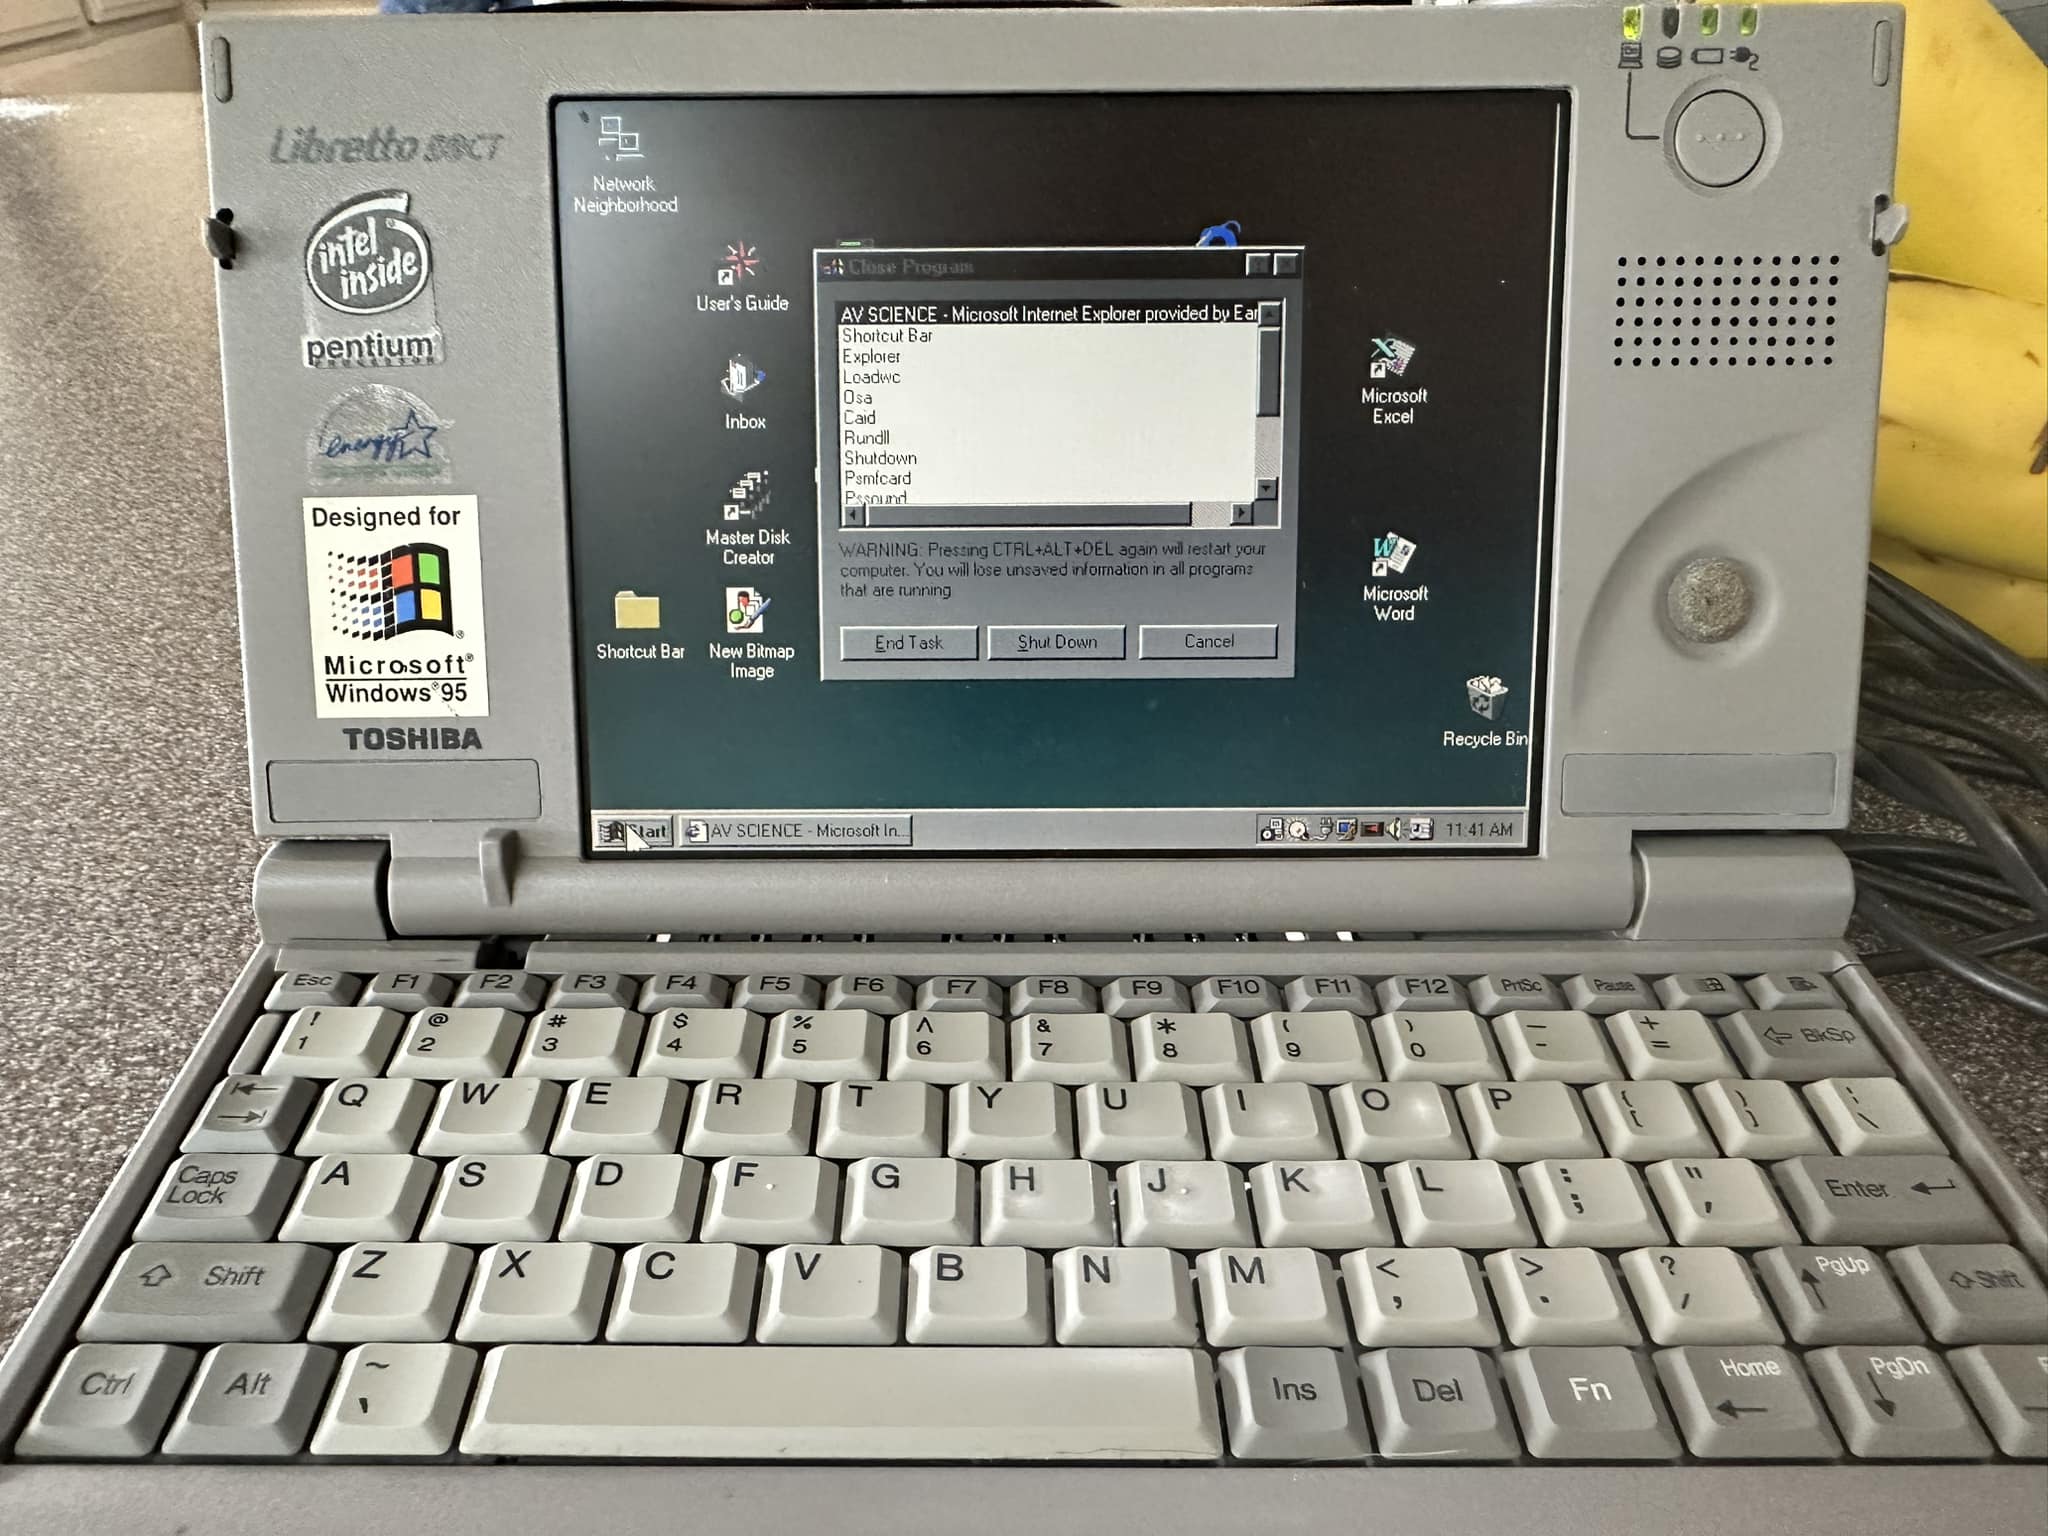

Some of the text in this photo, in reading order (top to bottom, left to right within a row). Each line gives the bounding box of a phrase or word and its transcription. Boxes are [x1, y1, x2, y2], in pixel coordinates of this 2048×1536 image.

[593, 175, 656, 192] Network
[574, 197, 678, 215] Neighborhood
[317, 216, 378, 274] intel
[340, 247, 418, 300] inside
[849, 259, 975, 277] Close Program
[697, 295, 789, 311] User's Guide
[841, 307, 865, 323] AV
[868, 306, 937, 322] SCIENCE
[952, 305, 1018, 322] Microsoft
[1022, 304, 1078, 321] Internet
[1082, 305, 1141, 324] Explorer
[1146, 304, 1207, 324] provided
[1212, 304, 1230, 323] by
[842, 328, 933, 343] Shortcut Bar
[307, 332, 433, 366] pentium
[843, 348, 901, 366] Explorer
[843, 369, 901, 384] Loadwc
[844, 390, 872, 405] Osa
[1361, 387, 1428, 404] Microsoft
[725, 413, 766, 429] Inbox
[844, 410, 876, 425] Caid
[1373, 408, 1414, 425] Excel
[844, 429, 890, 445] Rundll
[844, 451, 917, 466] Shutdown
[845, 470, 912, 486] Psmfcard
[845, 490, 907, 504] Pssound
[312, 505, 461, 531] Designed for
[706, 529, 791, 545] Master Disk
[723, 550, 775, 565] Creator
[928, 542, 988, 559] Pressing
[993, 541, 1114, 557] CTRL+ALT+DEL
[1119, 543, 1158, 559] again
[1161, 541, 1184, 556] will
[1187, 541, 1231, 556] restart
[1234, 544, 1266, 559] your
[840, 561, 1253, 579] computer. You will lose unsaved information in all programs
[840, 584, 867, 597] that
[872, 586, 894, 597] are
[1363, 584, 1428, 601] Microsoft
[1374, 605, 1415, 621] Word
[875, 635, 944, 652] End Task
[1017, 634, 1097, 651] Shut Down
[1185, 633, 1235, 649] Cancel
[597, 644, 685, 659] Shortcut Bar
[709, 643, 795, 661] New Bitmap
[731, 663, 775, 680] Image
[441, 683, 467, 702] 95
[342, 727, 482, 750] TOSHIBA
[1443, 731, 1528, 750] Recycle Bin
[711, 823, 732, 838] AV
[736, 823, 802, 838] SCIENCE
[817, 823, 880, 838] Microsoft
[1448, 822, 1513, 838] 11:41 AM
[293, 972, 332, 987] Esc
[391, 974, 419, 989] F1
[480, 974, 514, 989] F2
[573, 975, 606, 989] F3
[666, 975, 697, 990] F4
[760, 976, 790, 991] F5
[853, 977, 884, 992] F6
[947, 980, 977, 994] F7
[1038, 979, 1069, 994] F8
[1132, 980, 1163, 995] F9
[1218, 979, 1260, 994] F10
[1315, 979, 1351, 994] F11
[1405, 979, 1449, 994] F12
[1594, 978, 1636, 991] Pause
[298, 1036, 308, 1049] 1
[418, 1037, 436, 1052] 2
[542, 1037, 558, 1052] 3
[1800, 1027, 1856, 1044] BkSp
[666, 1038, 683, 1052] 4
[792, 1039, 807, 1054] 5
[916, 1040, 932, 1056] 6
[1037, 1043, 1053, 1056] 7
[1162, 1043, 1178, 1058] 8
[1286, 1042, 1301, 1057] 9
[1410, 1042, 1426, 1057] 0
[338, 1083, 369, 1107] Q
[462, 1083, 500, 1105] W
[585, 1082, 612, 1105] E
[716, 1083, 742, 1105] R
[848, 1085, 873, 1107] T
[977, 1086, 1003, 1109] Y
[1103, 1088, 1127, 1110] U
[1237, 1089, 1246, 1111] I
[1362, 1088, 1390, 1111] O
[1488, 1088, 1512, 1110] P
[178, 1165, 238, 1187] Caps
[321, 1161, 350, 1186] A
[459, 1162, 486, 1188] S
[595, 1162, 623, 1186] D
[733, 1163, 759, 1187] F
[871, 1163, 900, 1190] G
[1009, 1166, 1035, 1192] H
[1147, 1168, 1167, 1193] J
[1280, 1167, 1311, 1193] K
[1416, 1167, 1444, 1192] L
[165, 1185, 227, 1204] Lock
[1824, 1178, 1890, 1199] Enter
[352, 1249, 387, 1279] Z
[499, 1248, 532, 1279] X
[645, 1251, 676, 1280] C
[794, 1252, 821, 1281] V
[936, 1253, 965, 1281] B
[1082, 1255, 1111, 1285] N
[1228, 1255, 1266, 1285] M
[1815, 1255, 1870, 1277] PgUp
[204, 1265, 265, 1288] Shift
[1720, 1358, 1781, 1377] Home
[1869, 1357, 1929, 1380] PgDn
[80, 1372, 135, 1396] Ctrl
[224, 1372, 272, 1396] Alt
[1272, 1377, 1317, 1402] Ins
[1412, 1378, 1464, 1403] Del
[1569, 1376, 1612, 1401] Fn
